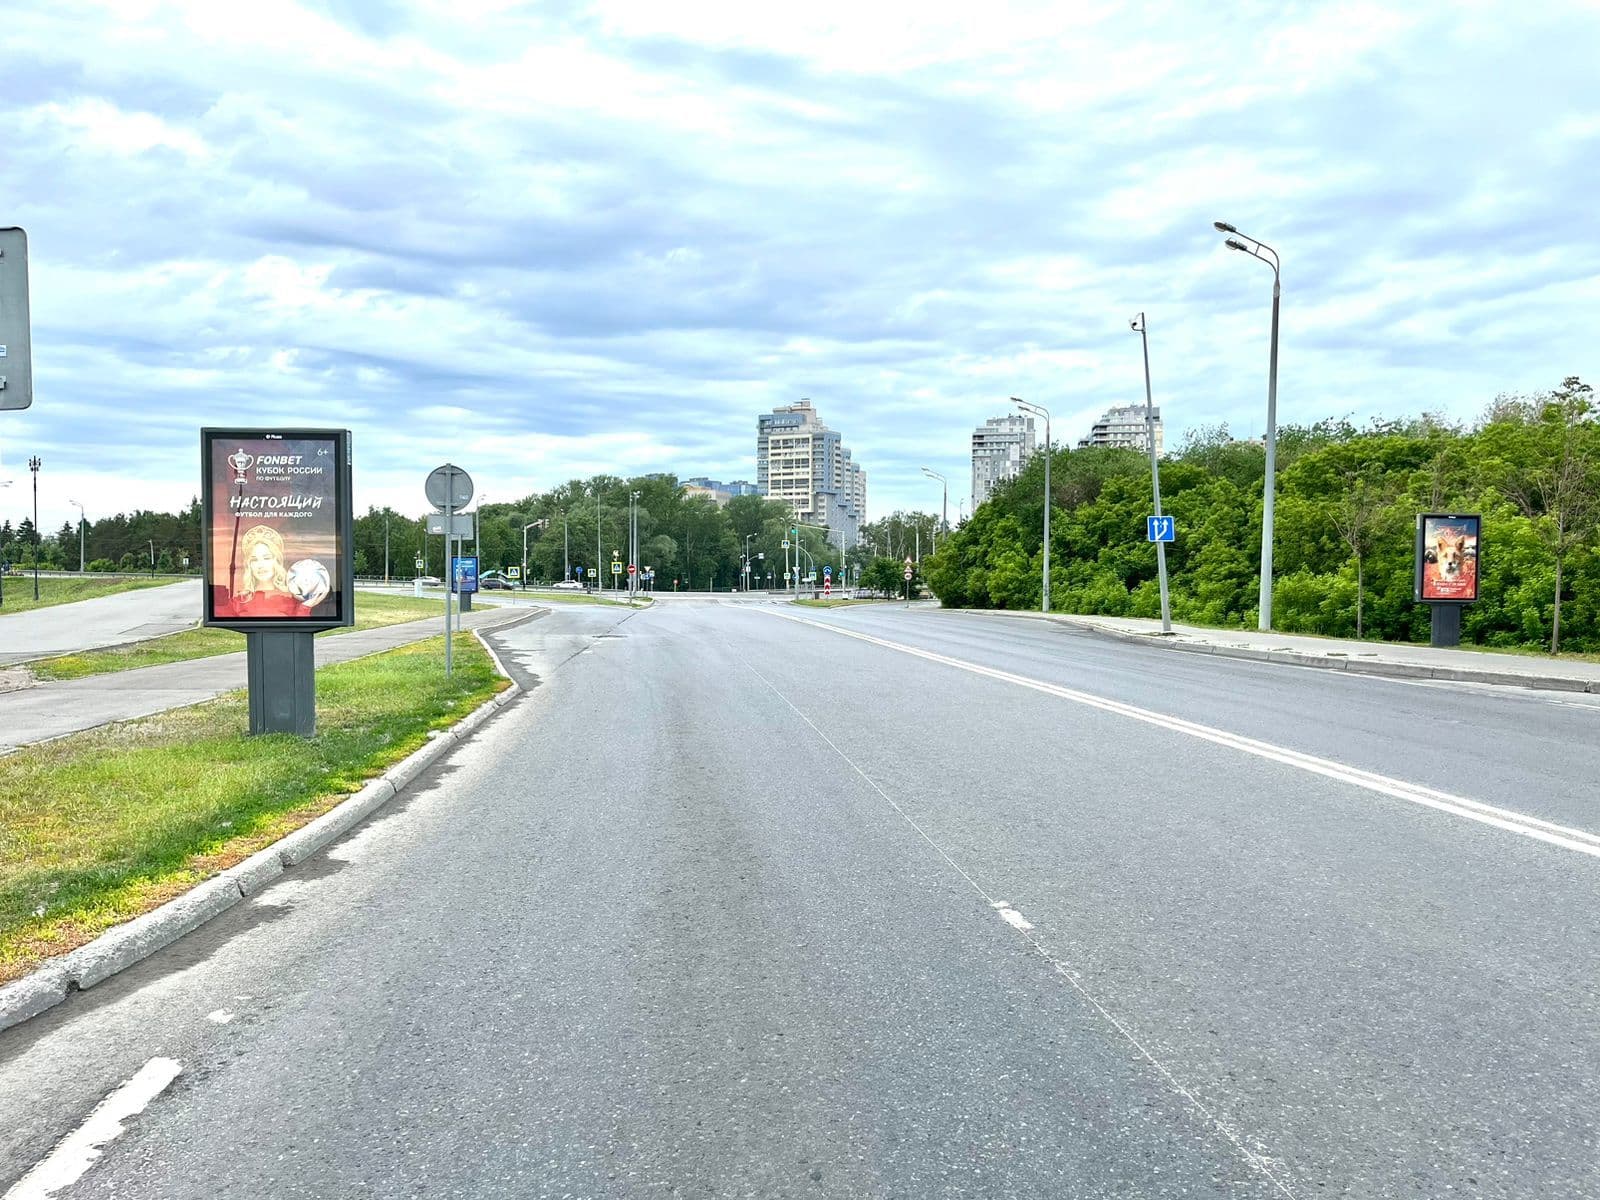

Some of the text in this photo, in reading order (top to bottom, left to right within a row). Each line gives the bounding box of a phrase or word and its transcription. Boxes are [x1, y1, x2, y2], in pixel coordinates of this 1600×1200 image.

[317, 448, 329, 456] 6+
[256, 455, 303, 465] FONBET
[229, 495, 323, 509] НАСТОЯЩИЙ
